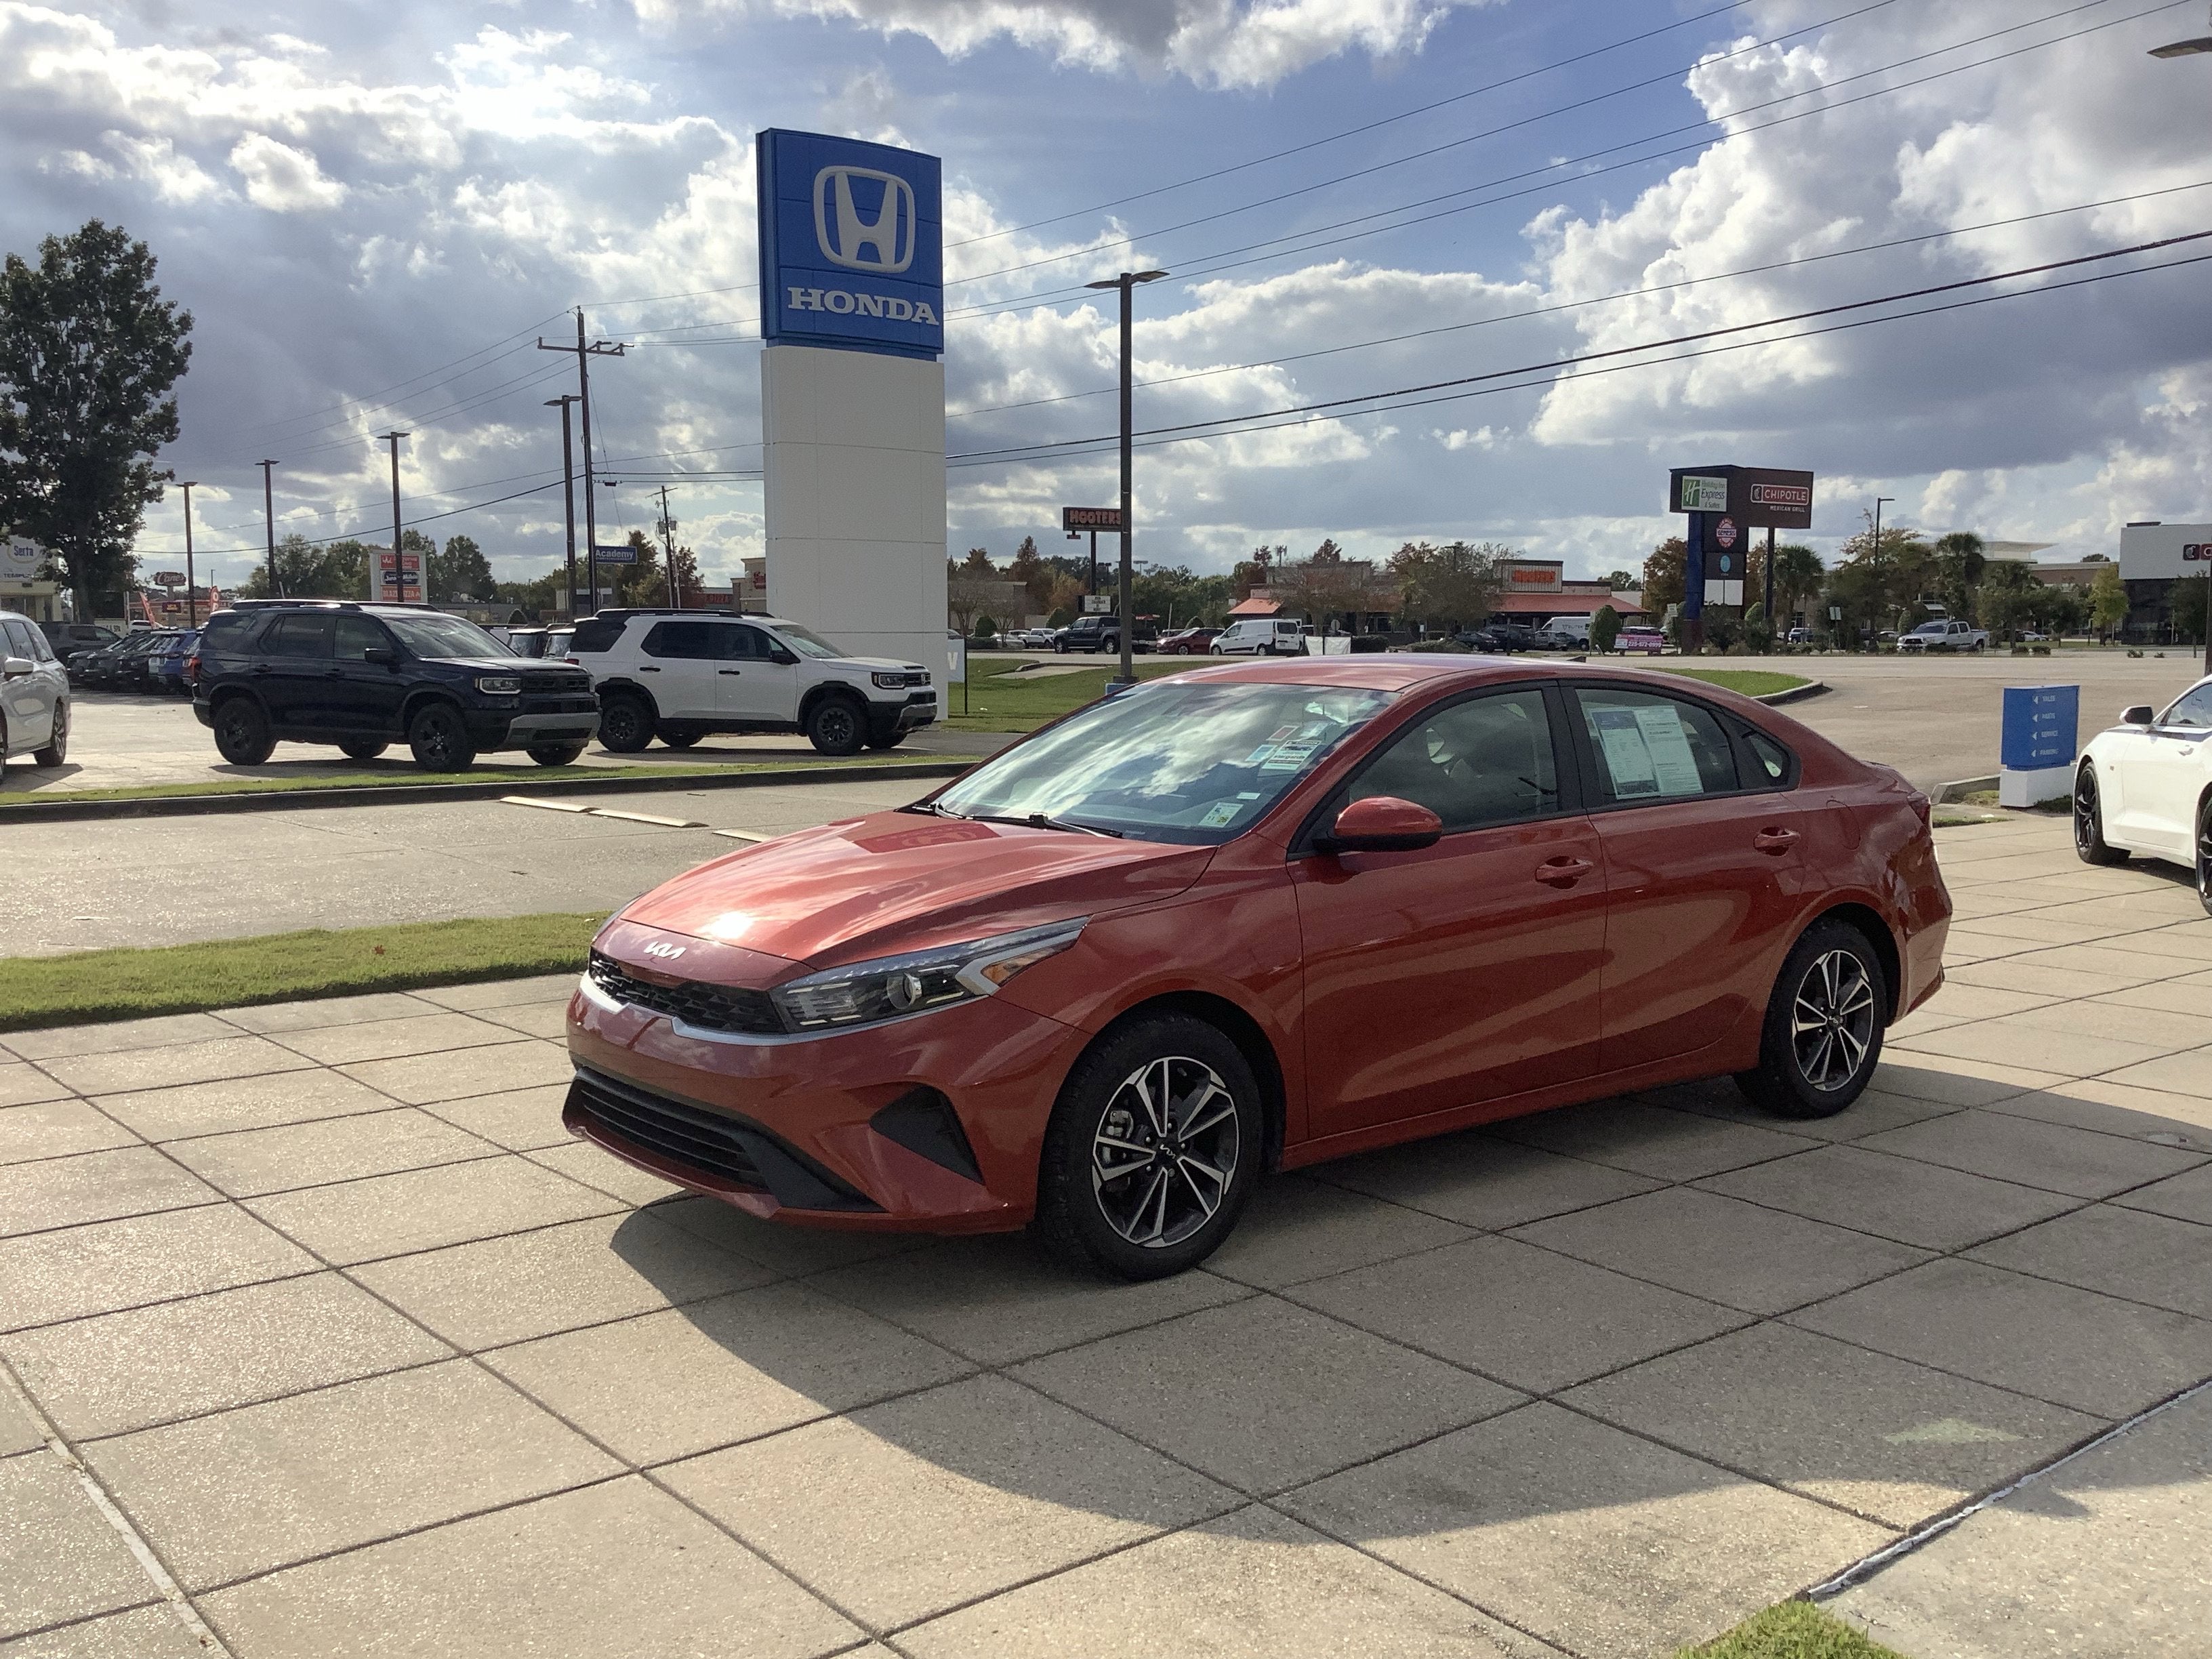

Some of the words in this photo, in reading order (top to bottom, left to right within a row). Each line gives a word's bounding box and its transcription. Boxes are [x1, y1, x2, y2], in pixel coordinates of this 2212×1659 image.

[787, 287, 939, 326] HONDA
[1701, 488, 1725, 501] Express
[1764, 489, 1807, 501] CHIPOTLE
[1069, 510, 1122, 525] HOOTERS
[14, 545, 34, 556] Serta
[596, 550, 634, 560] Academy
